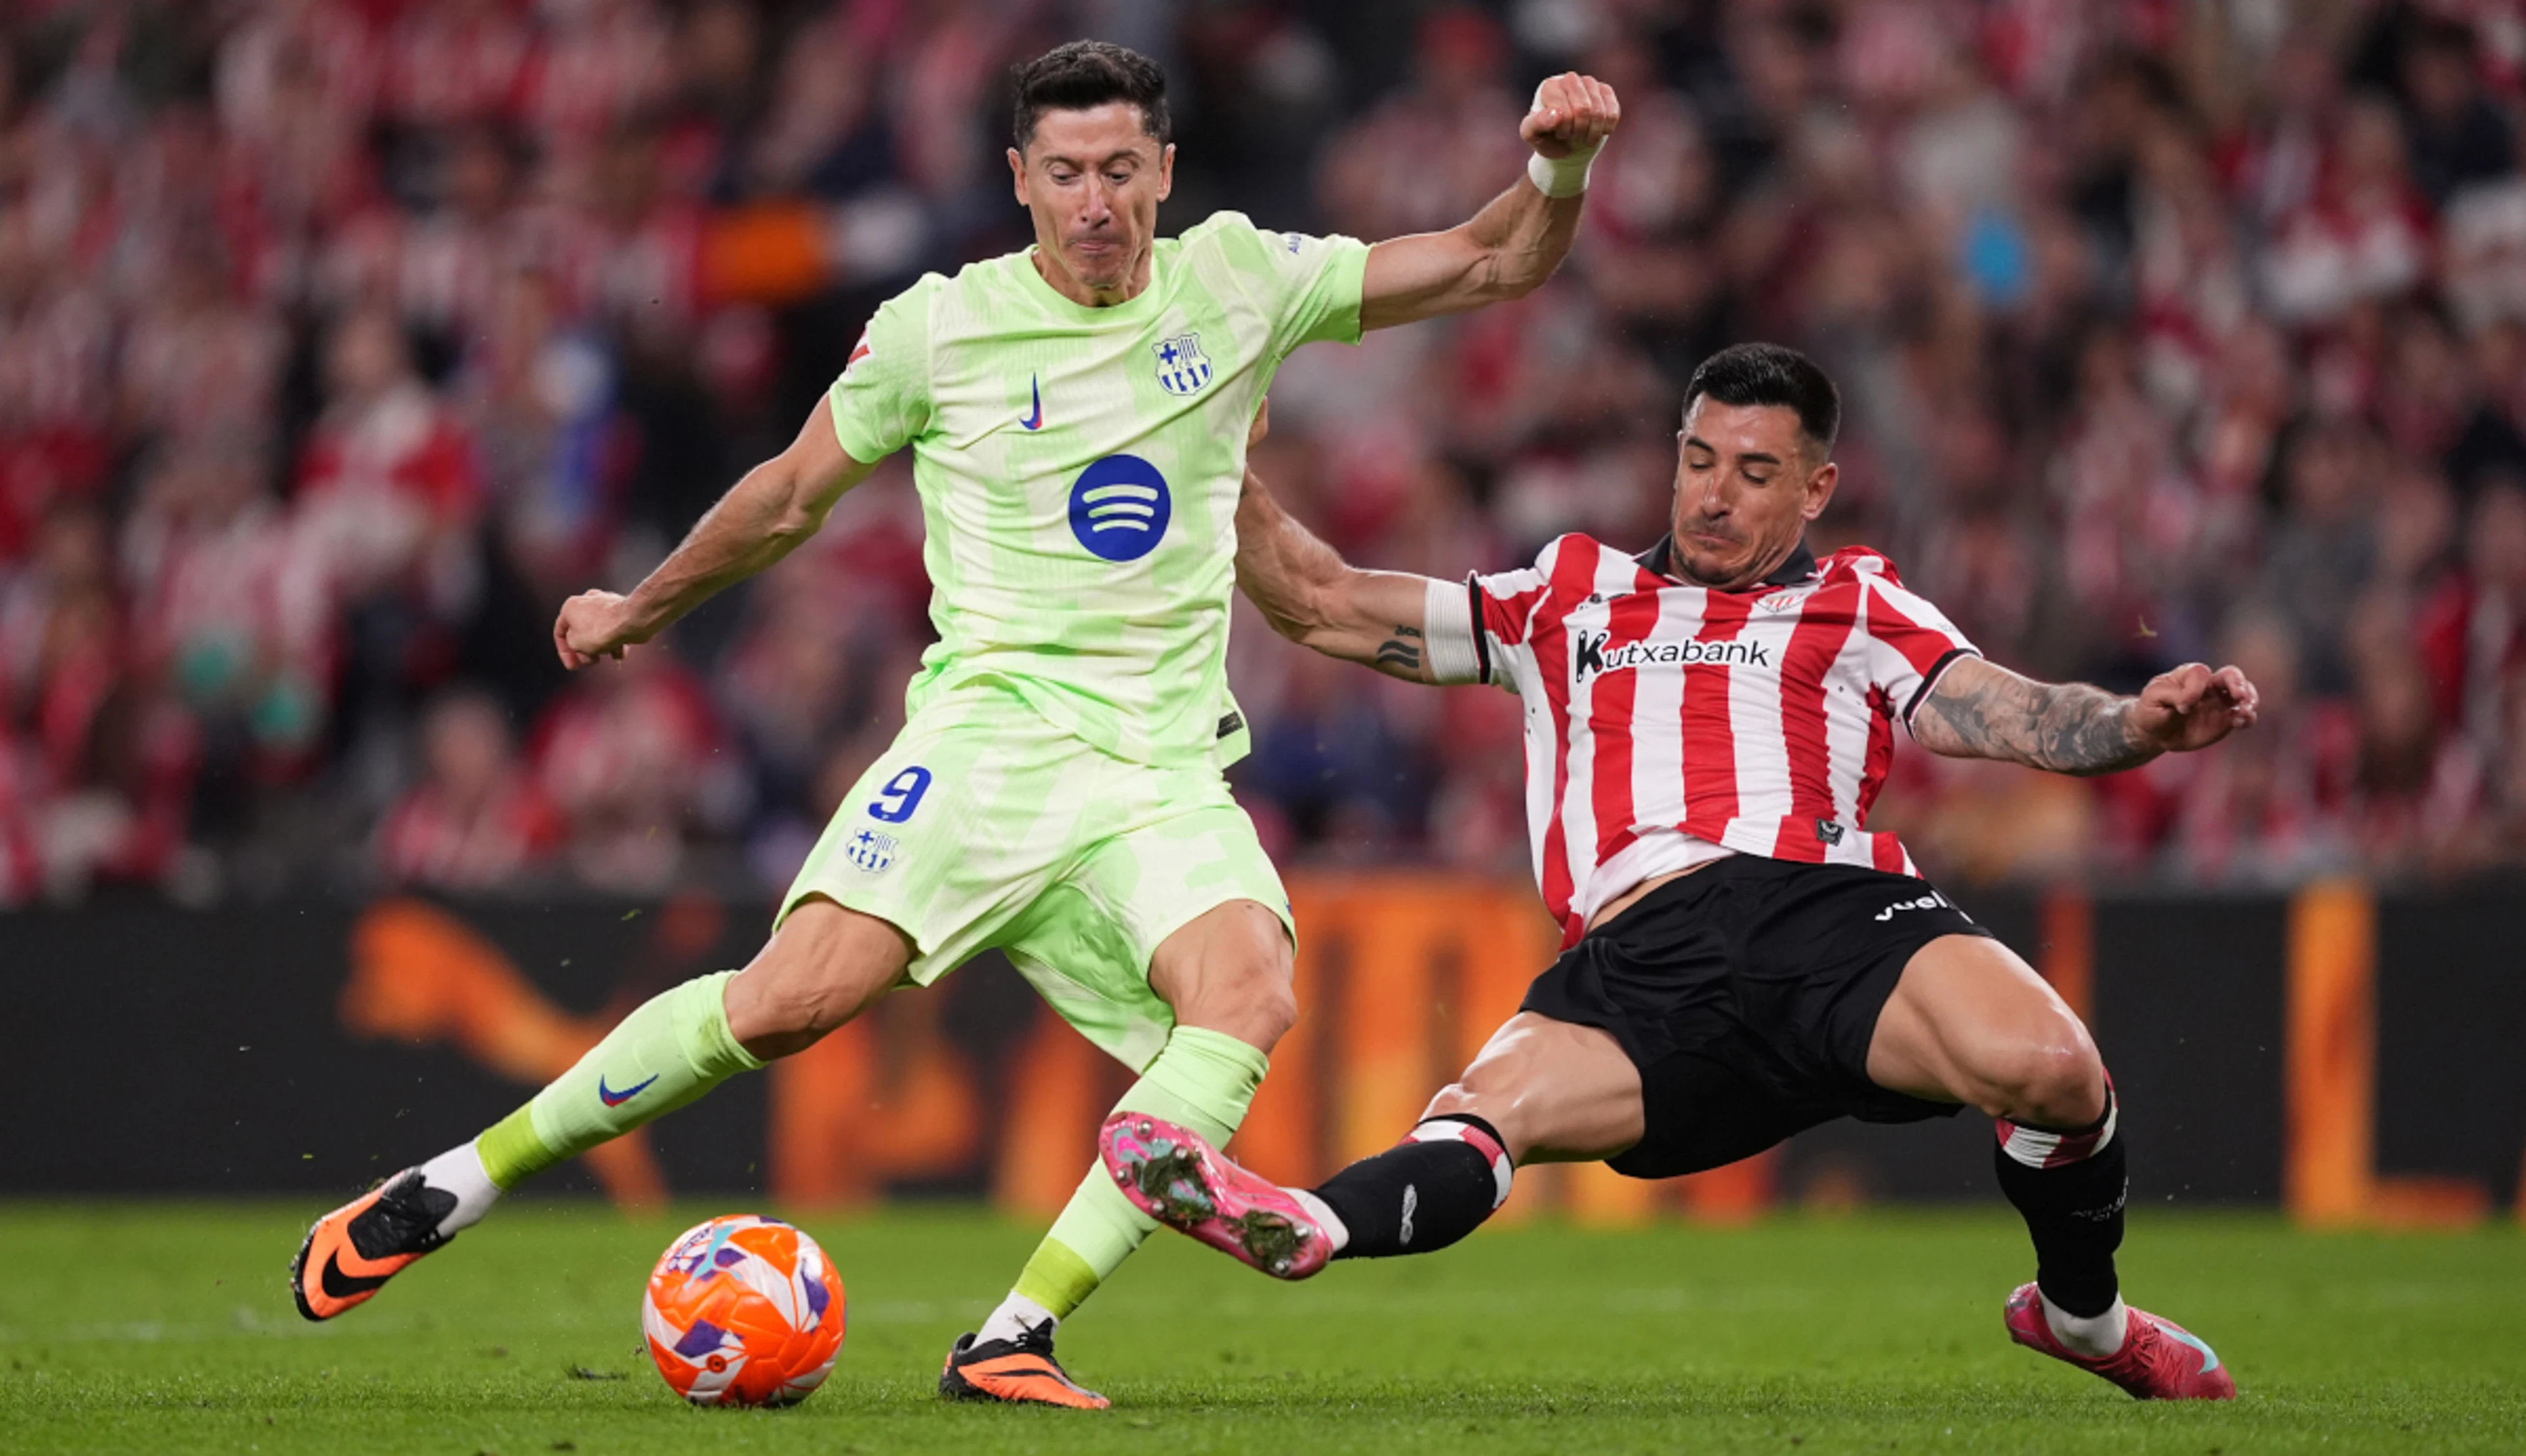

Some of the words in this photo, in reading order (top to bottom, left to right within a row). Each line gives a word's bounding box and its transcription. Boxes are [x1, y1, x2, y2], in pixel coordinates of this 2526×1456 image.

[1576, 629, 1770, 683] Kutxabank
[868, 765, 932, 823] 9
[1875, 890, 1974, 924] vuel
